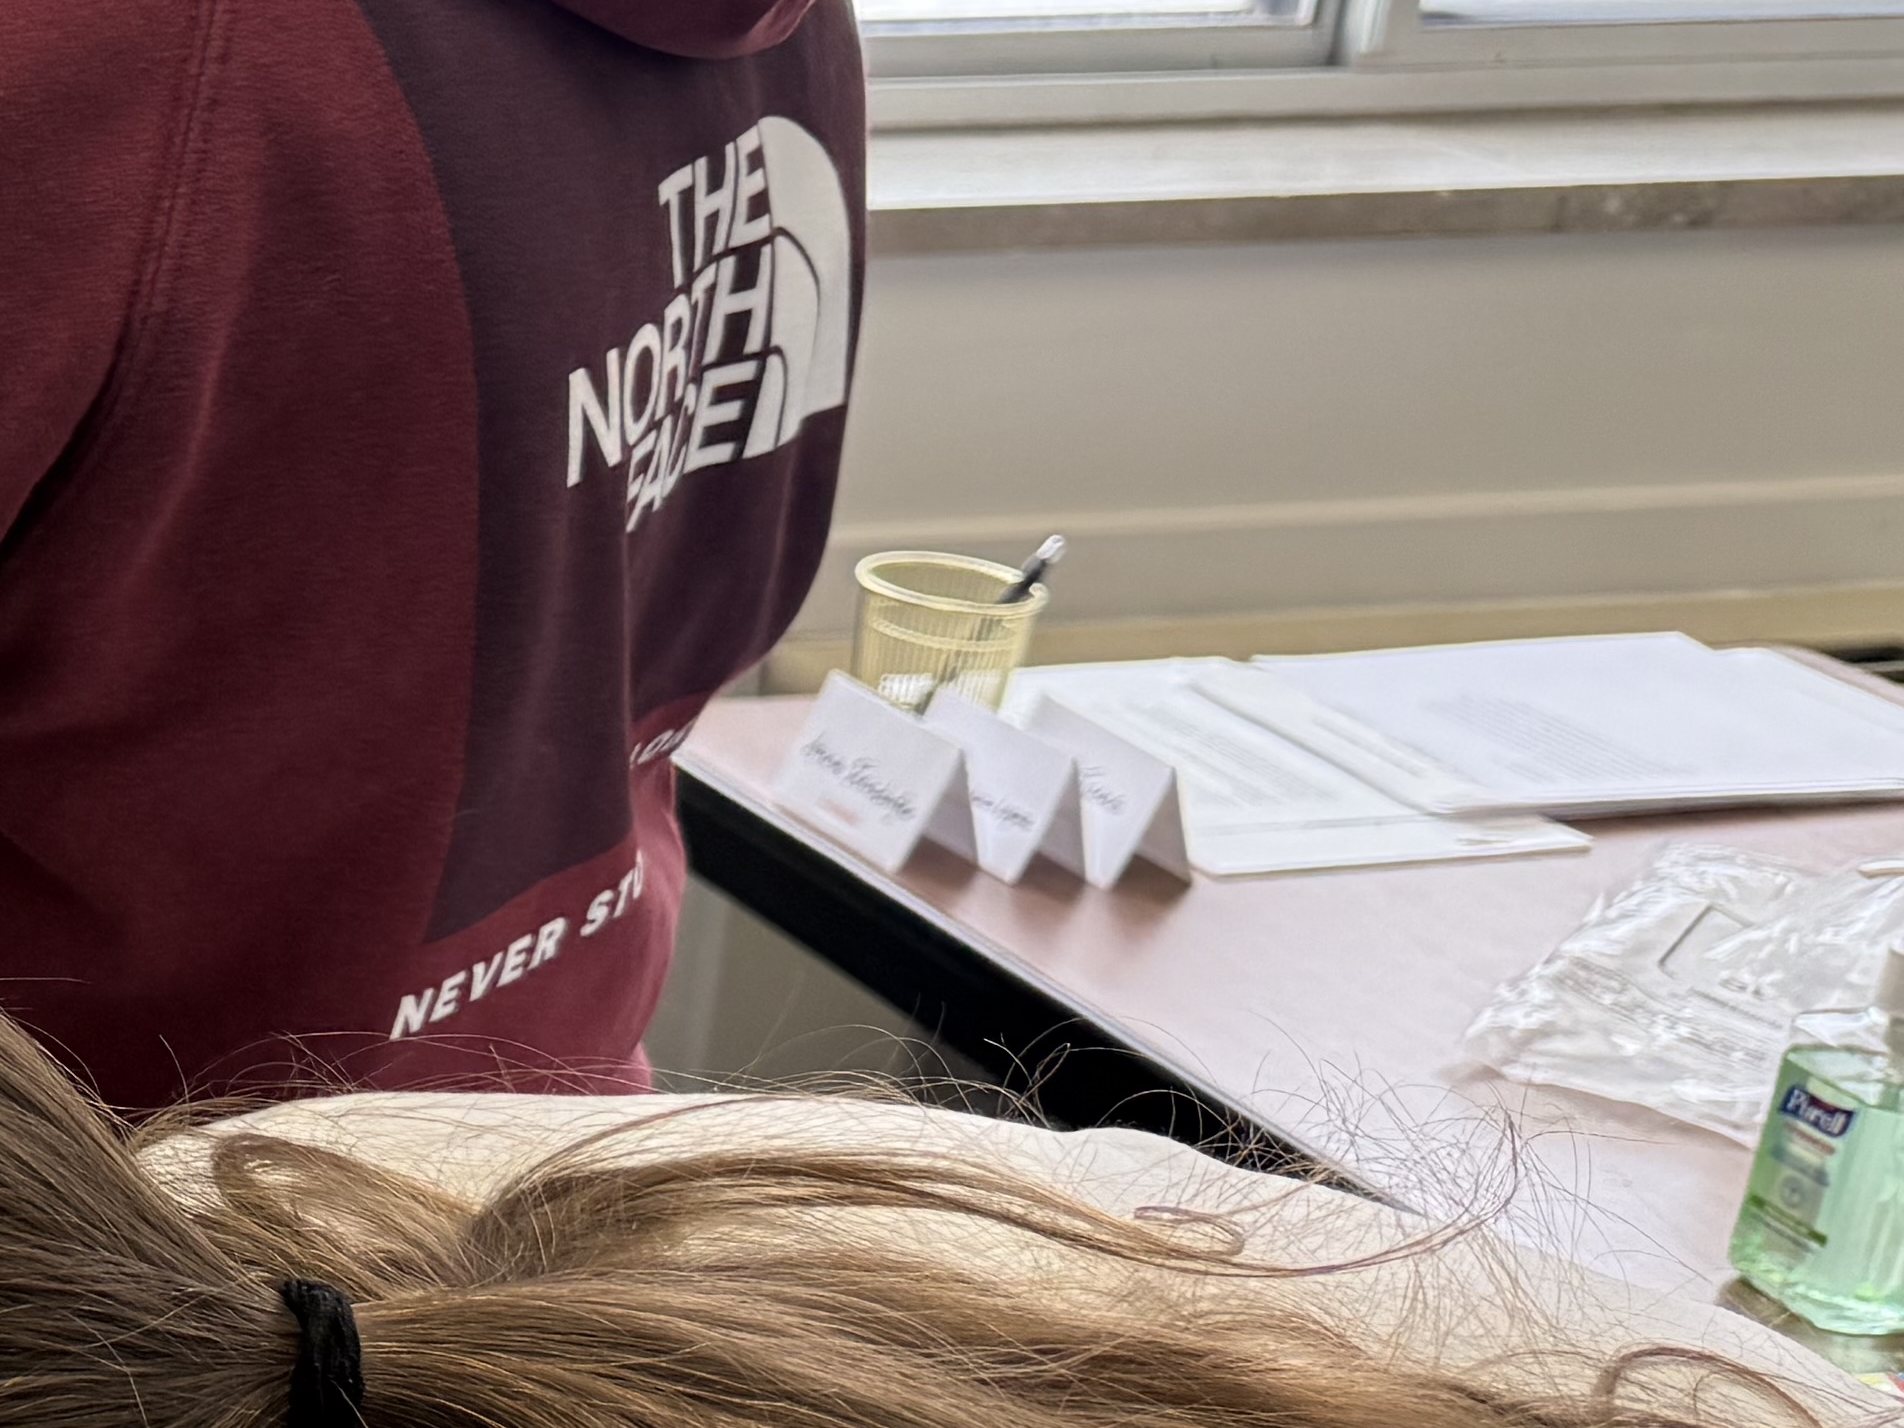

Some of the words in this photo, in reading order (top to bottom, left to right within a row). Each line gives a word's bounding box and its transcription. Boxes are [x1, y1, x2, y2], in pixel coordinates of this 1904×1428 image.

[658, 124, 772, 285] THE
[566, 245, 772, 488] NORTH
[624, 360, 762, 534] FACE
[390, 917, 567, 1039] NEVER
